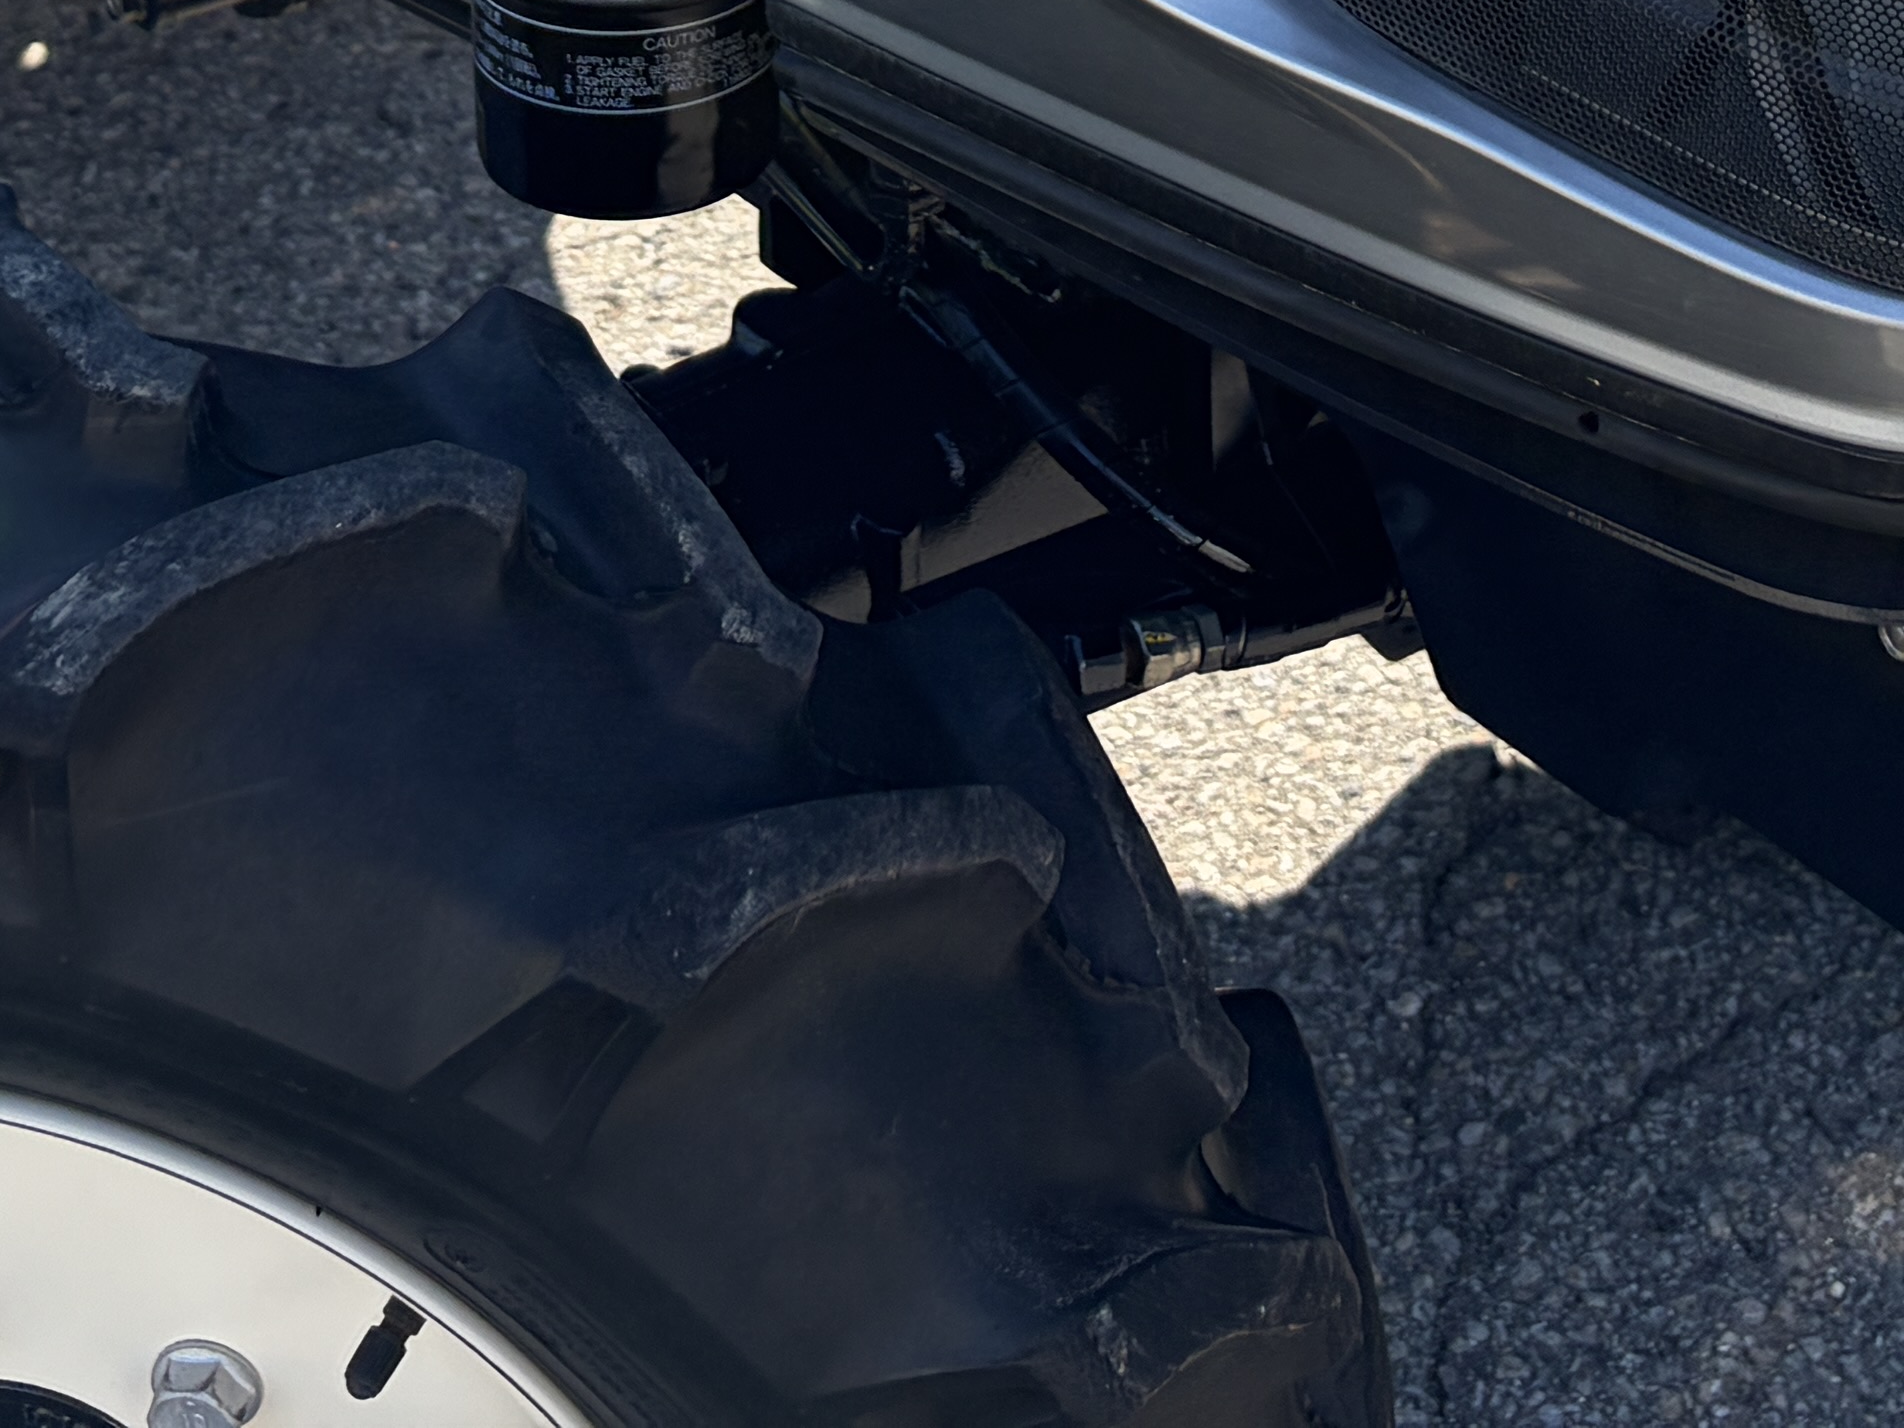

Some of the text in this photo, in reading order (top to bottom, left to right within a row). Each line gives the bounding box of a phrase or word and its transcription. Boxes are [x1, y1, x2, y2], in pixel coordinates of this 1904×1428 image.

[642, 25, 716, 52] CAUTION
[654, 53, 672, 65] TO
[576, 64, 593, 75] OF
[576, 86, 617, 97] START
